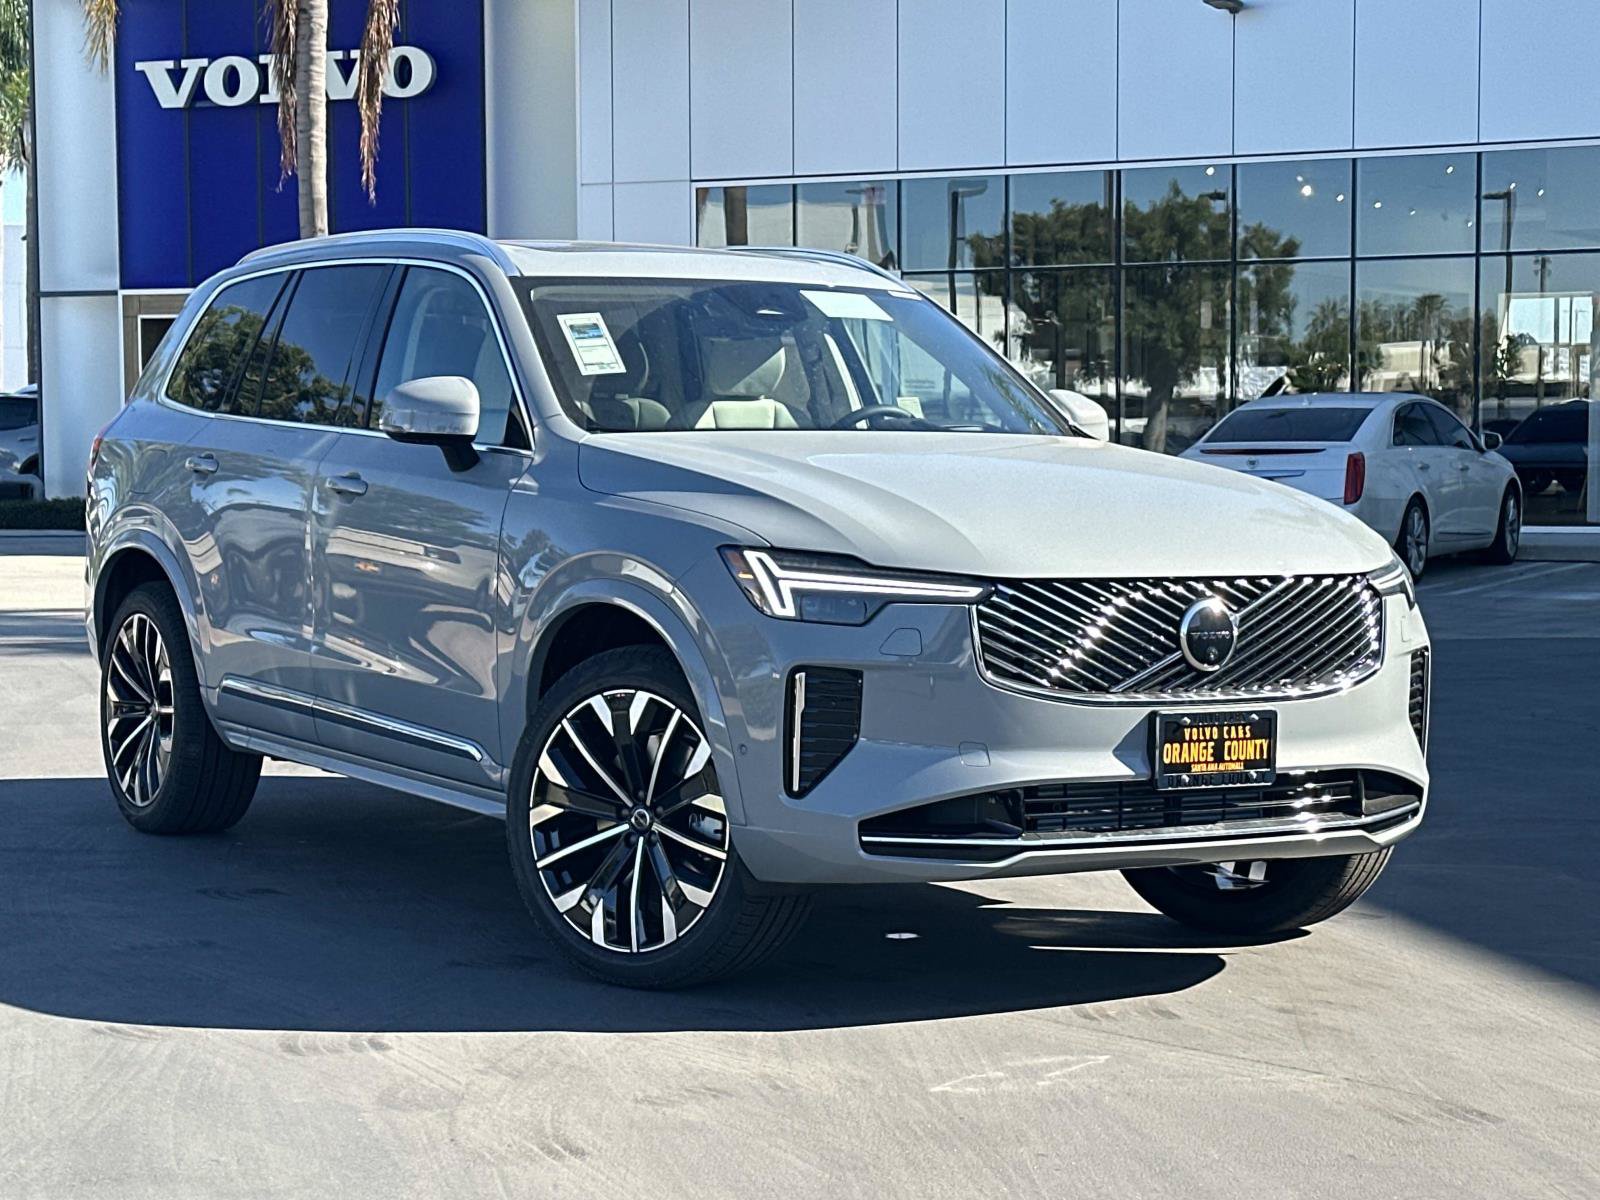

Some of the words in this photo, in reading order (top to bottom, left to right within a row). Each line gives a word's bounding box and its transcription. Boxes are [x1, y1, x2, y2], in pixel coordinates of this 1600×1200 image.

[1190, 630, 1231, 640] VOLVO
[1184, 726, 1218, 741] VOLVO
[1224, 725, 1251, 739] CARS
[1163, 741, 1215, 764] ORANGE
[1224, 739, 1269, 761] COUNTY
